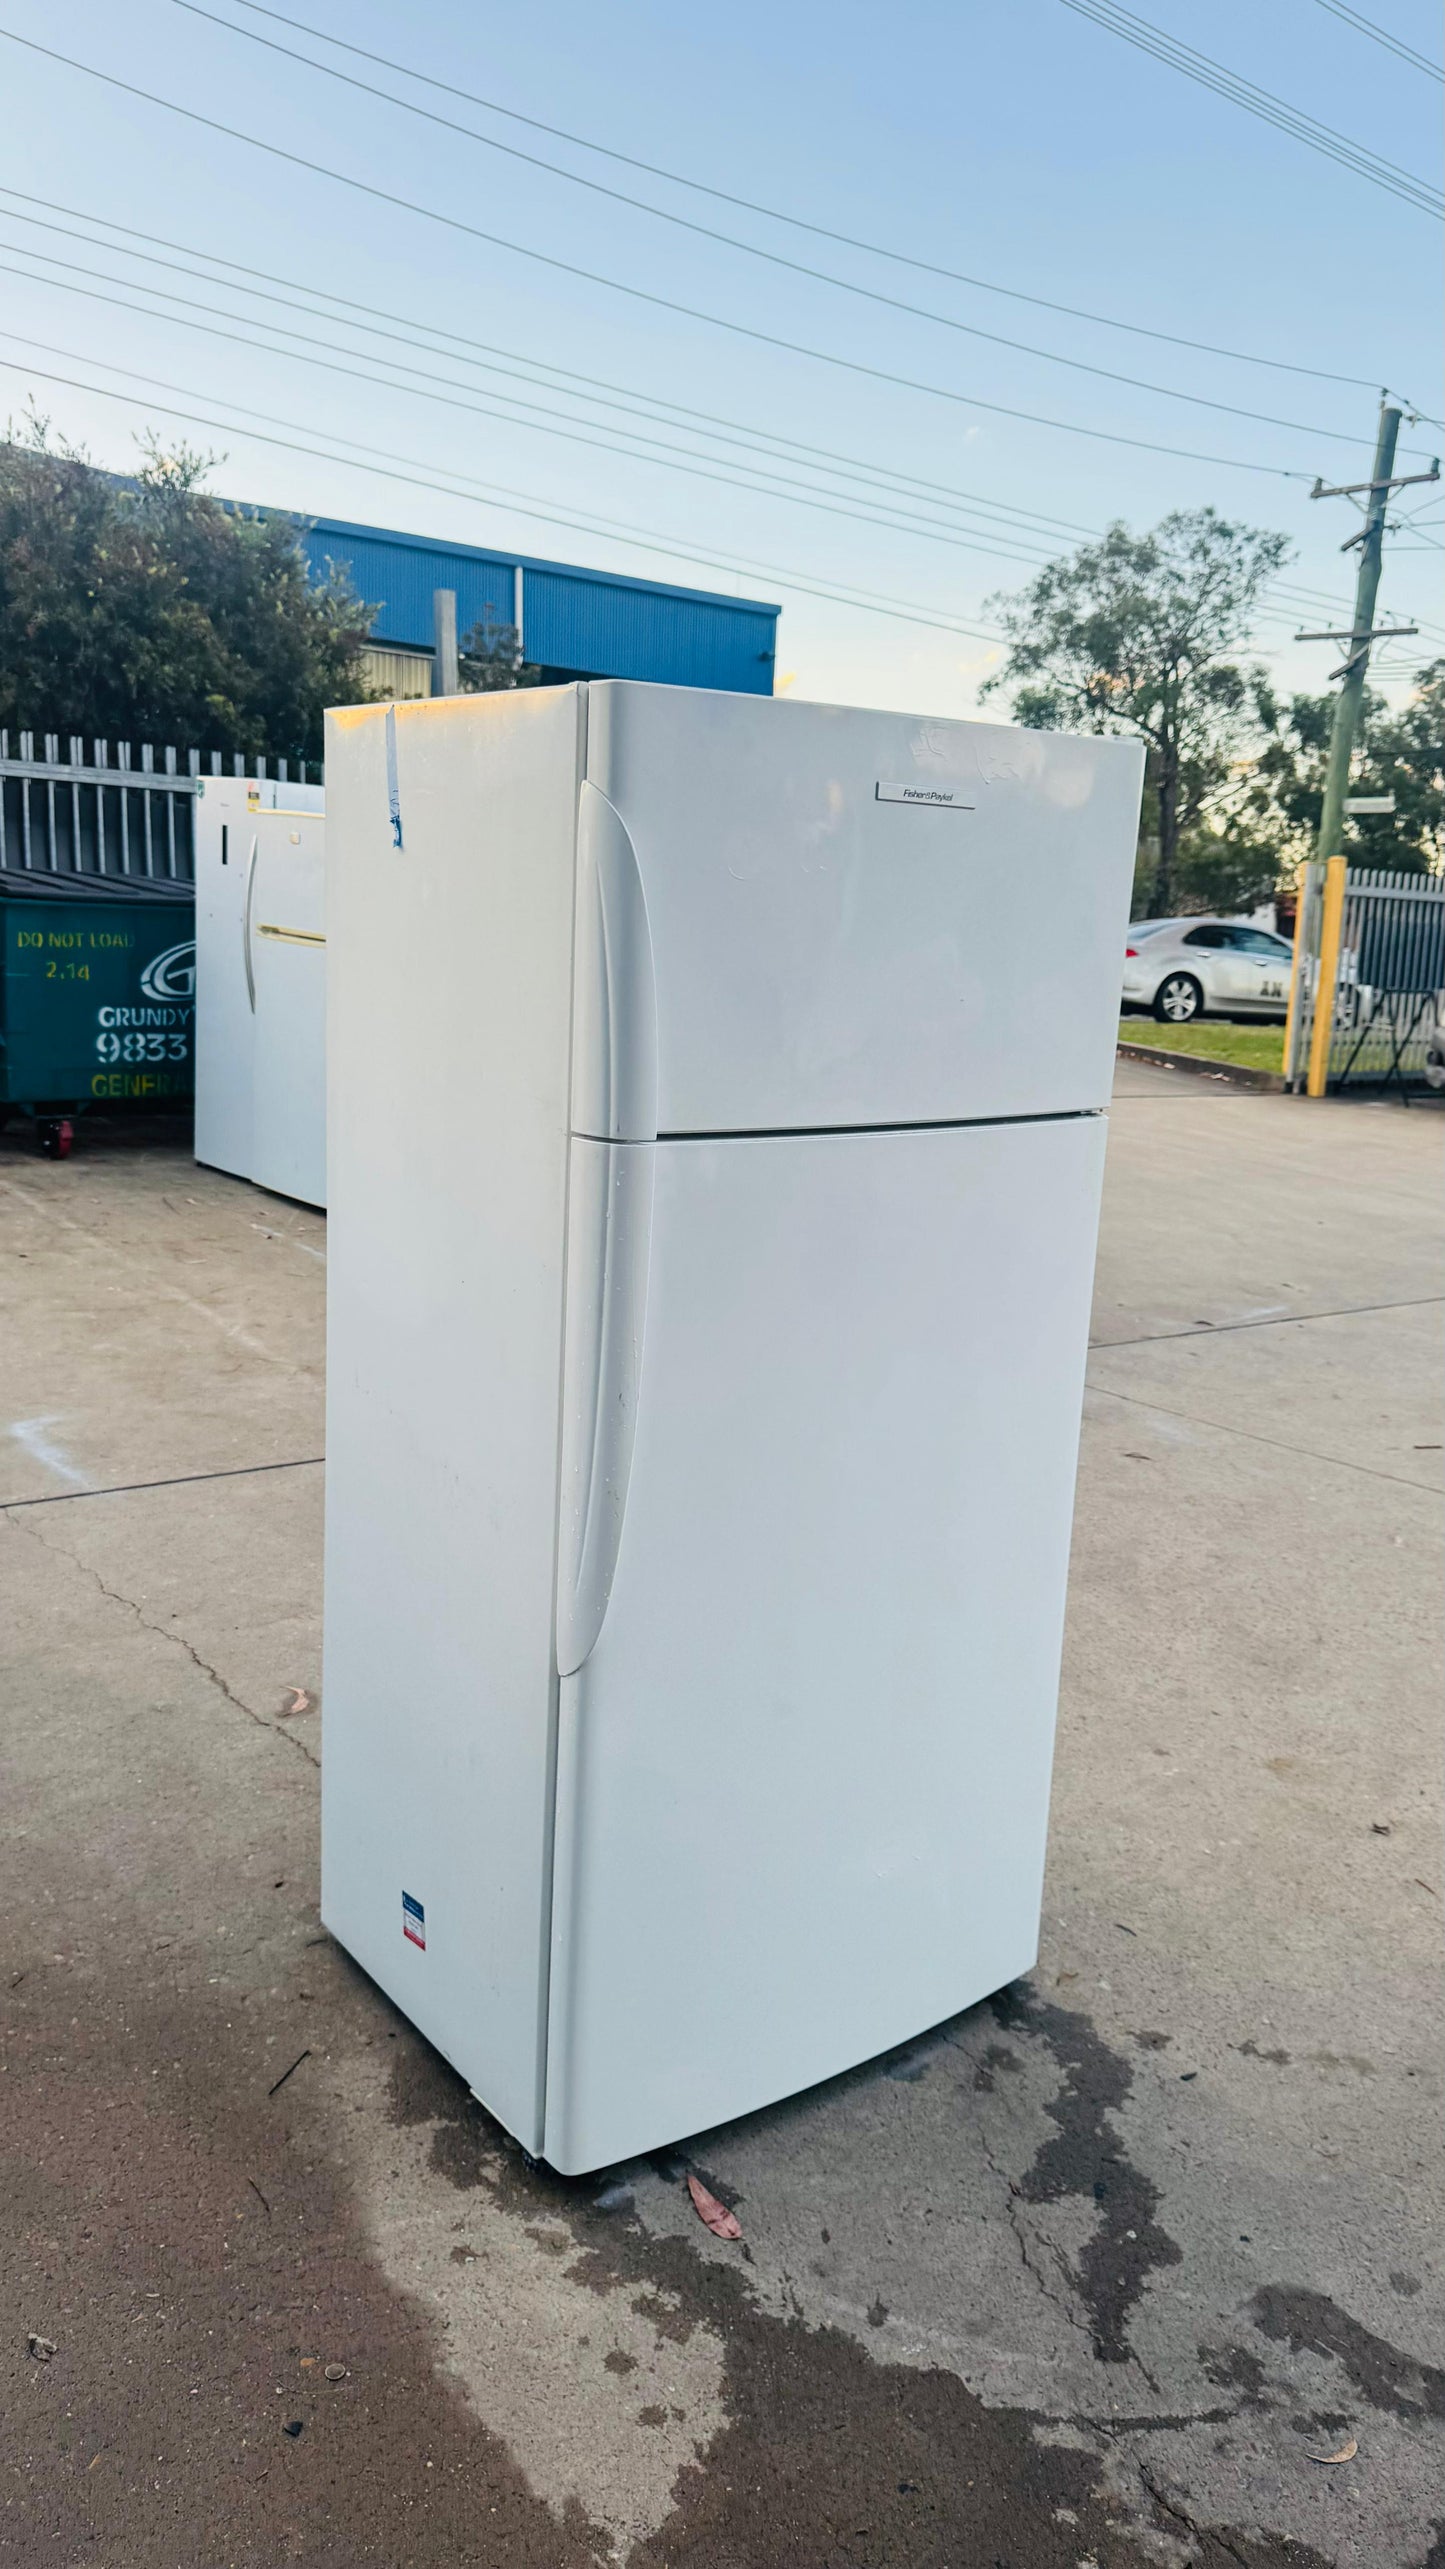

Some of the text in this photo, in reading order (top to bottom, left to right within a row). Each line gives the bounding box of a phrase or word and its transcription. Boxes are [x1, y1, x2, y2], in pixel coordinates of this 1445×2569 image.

[17, 931, 135, 948] DO NOT LOAD
[96, 1032, 188, 1063] 9833
